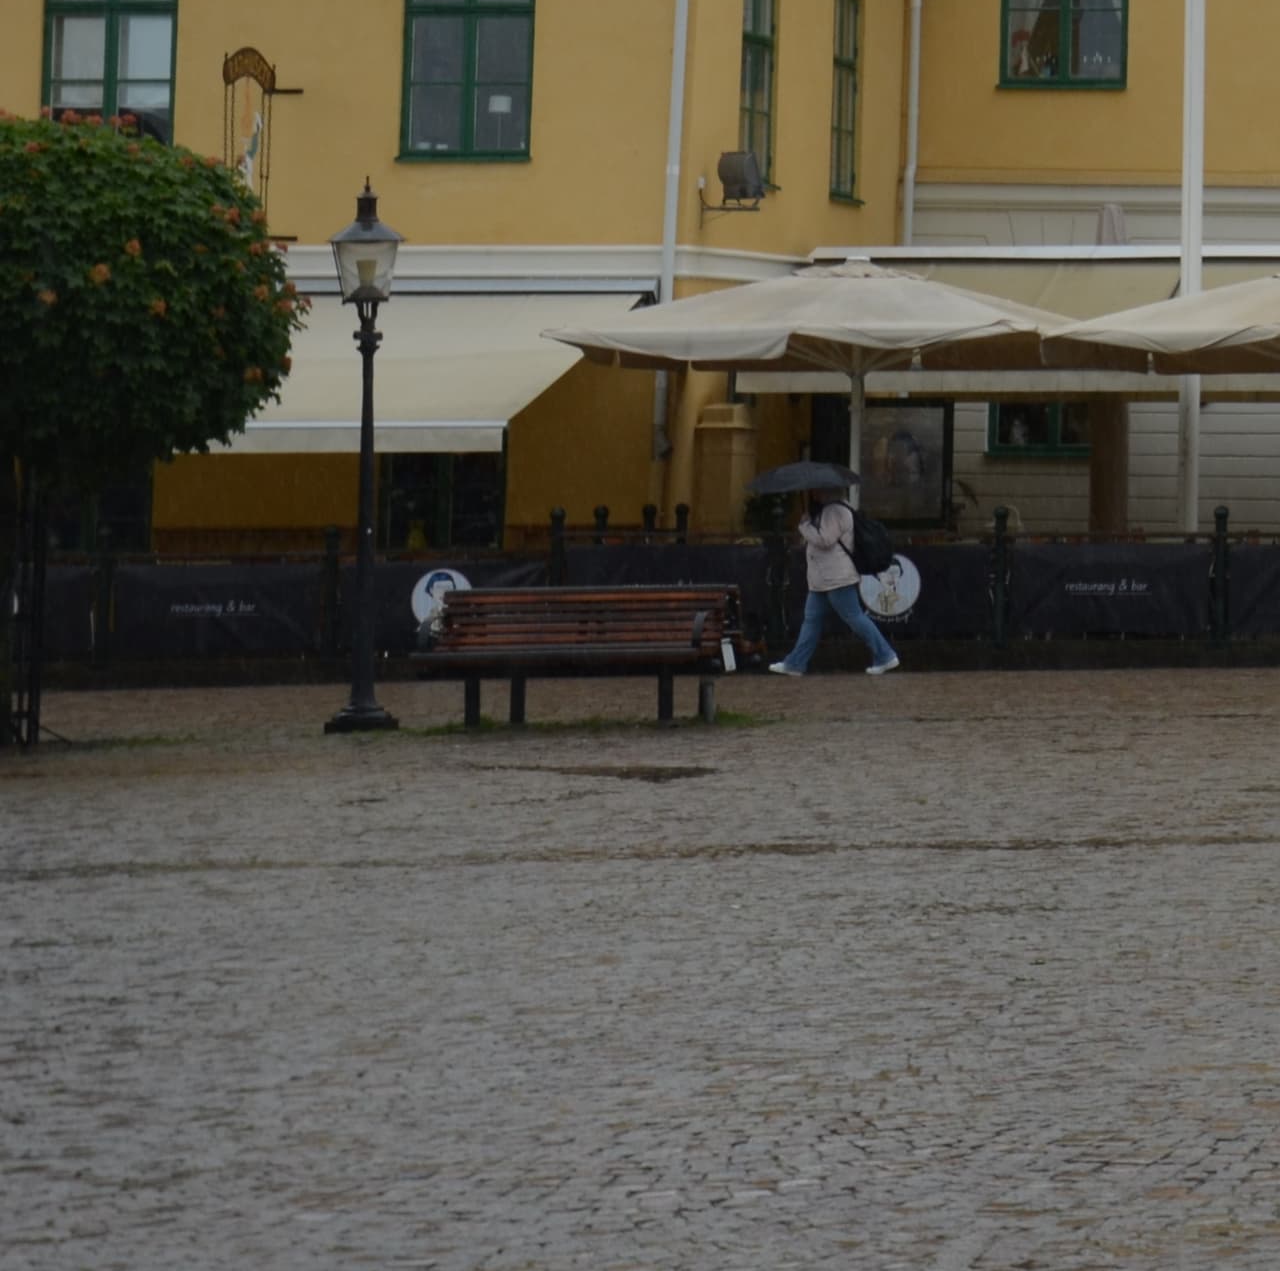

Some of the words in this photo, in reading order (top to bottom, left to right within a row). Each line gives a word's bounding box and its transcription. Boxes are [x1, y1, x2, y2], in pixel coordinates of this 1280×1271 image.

[1065, 580, 1115, 595] restaurang
[1119, 578, 1128, 591] &
[1131, 578, 1148, 591] bar
[171, 601, 222, 616] restaurang
[240, 599, 256, 611] bar
